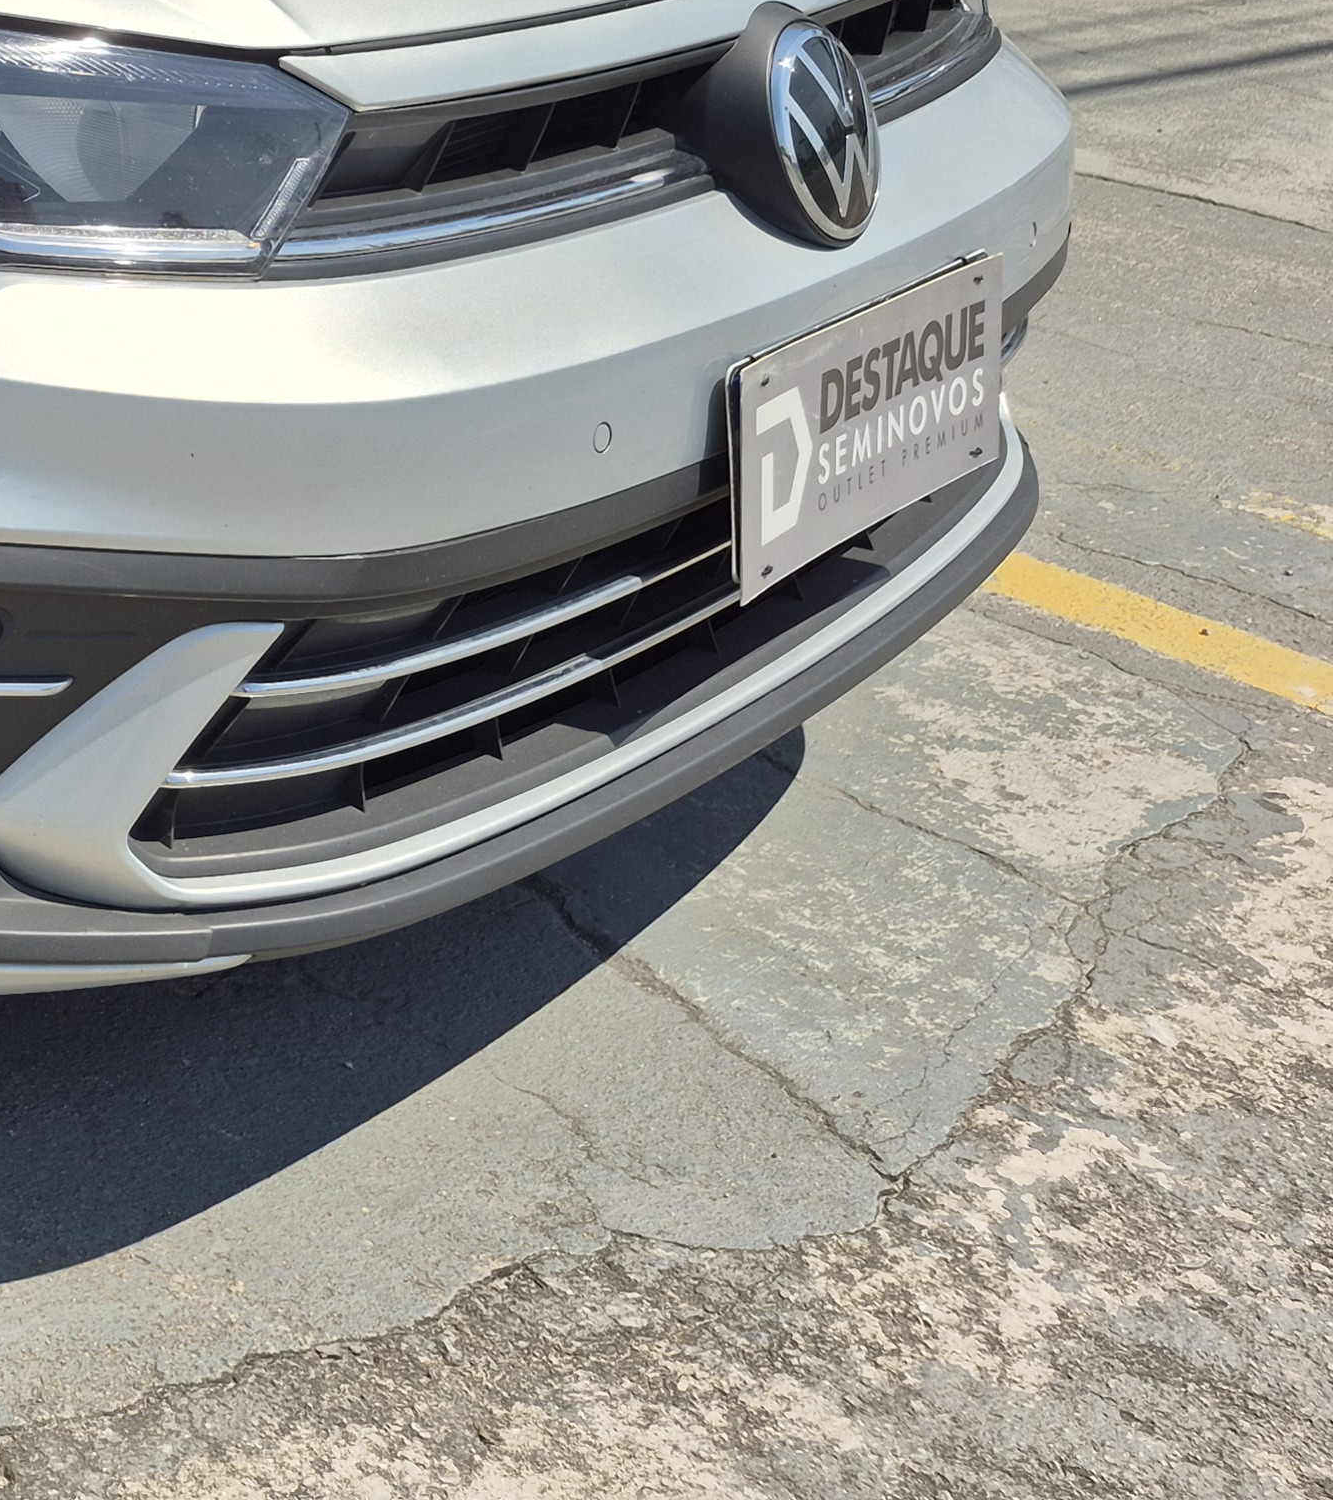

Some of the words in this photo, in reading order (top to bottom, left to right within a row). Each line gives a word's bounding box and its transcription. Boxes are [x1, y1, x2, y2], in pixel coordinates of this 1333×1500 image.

[818, 367, 985, 485] SEMINOVOS
[820, 299, 986, 435] DESTAQUE
[818, 459, 888, 512] OUTLET
[901, 413, 985, 467] PREMIUM
